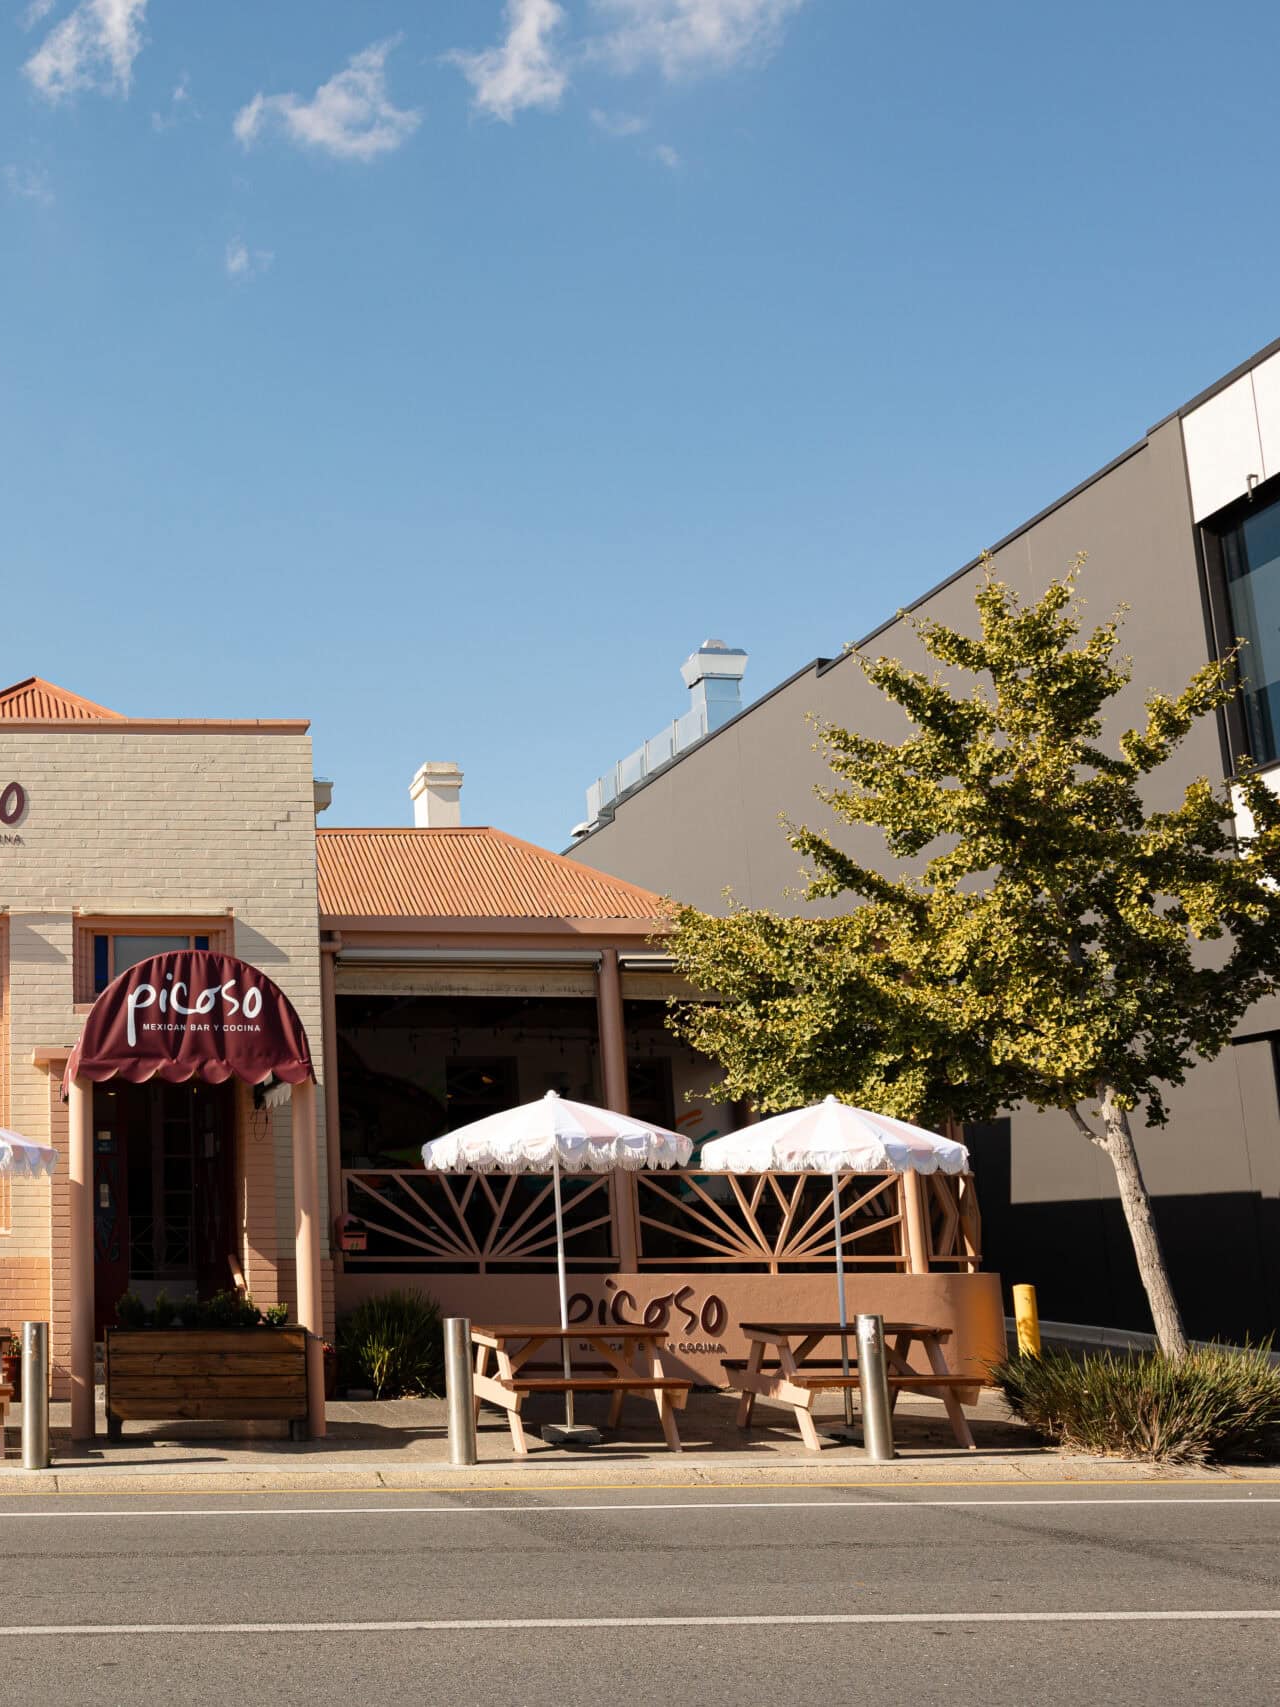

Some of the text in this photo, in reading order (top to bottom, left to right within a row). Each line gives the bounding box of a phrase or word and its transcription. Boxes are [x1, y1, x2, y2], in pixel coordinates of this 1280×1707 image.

[127, 972, 262, 1047] picoso
[143, 1023, 261, 1032] MEXICAN BAR Y COCINA
[679, 1343, 723, 1352] COCINA
